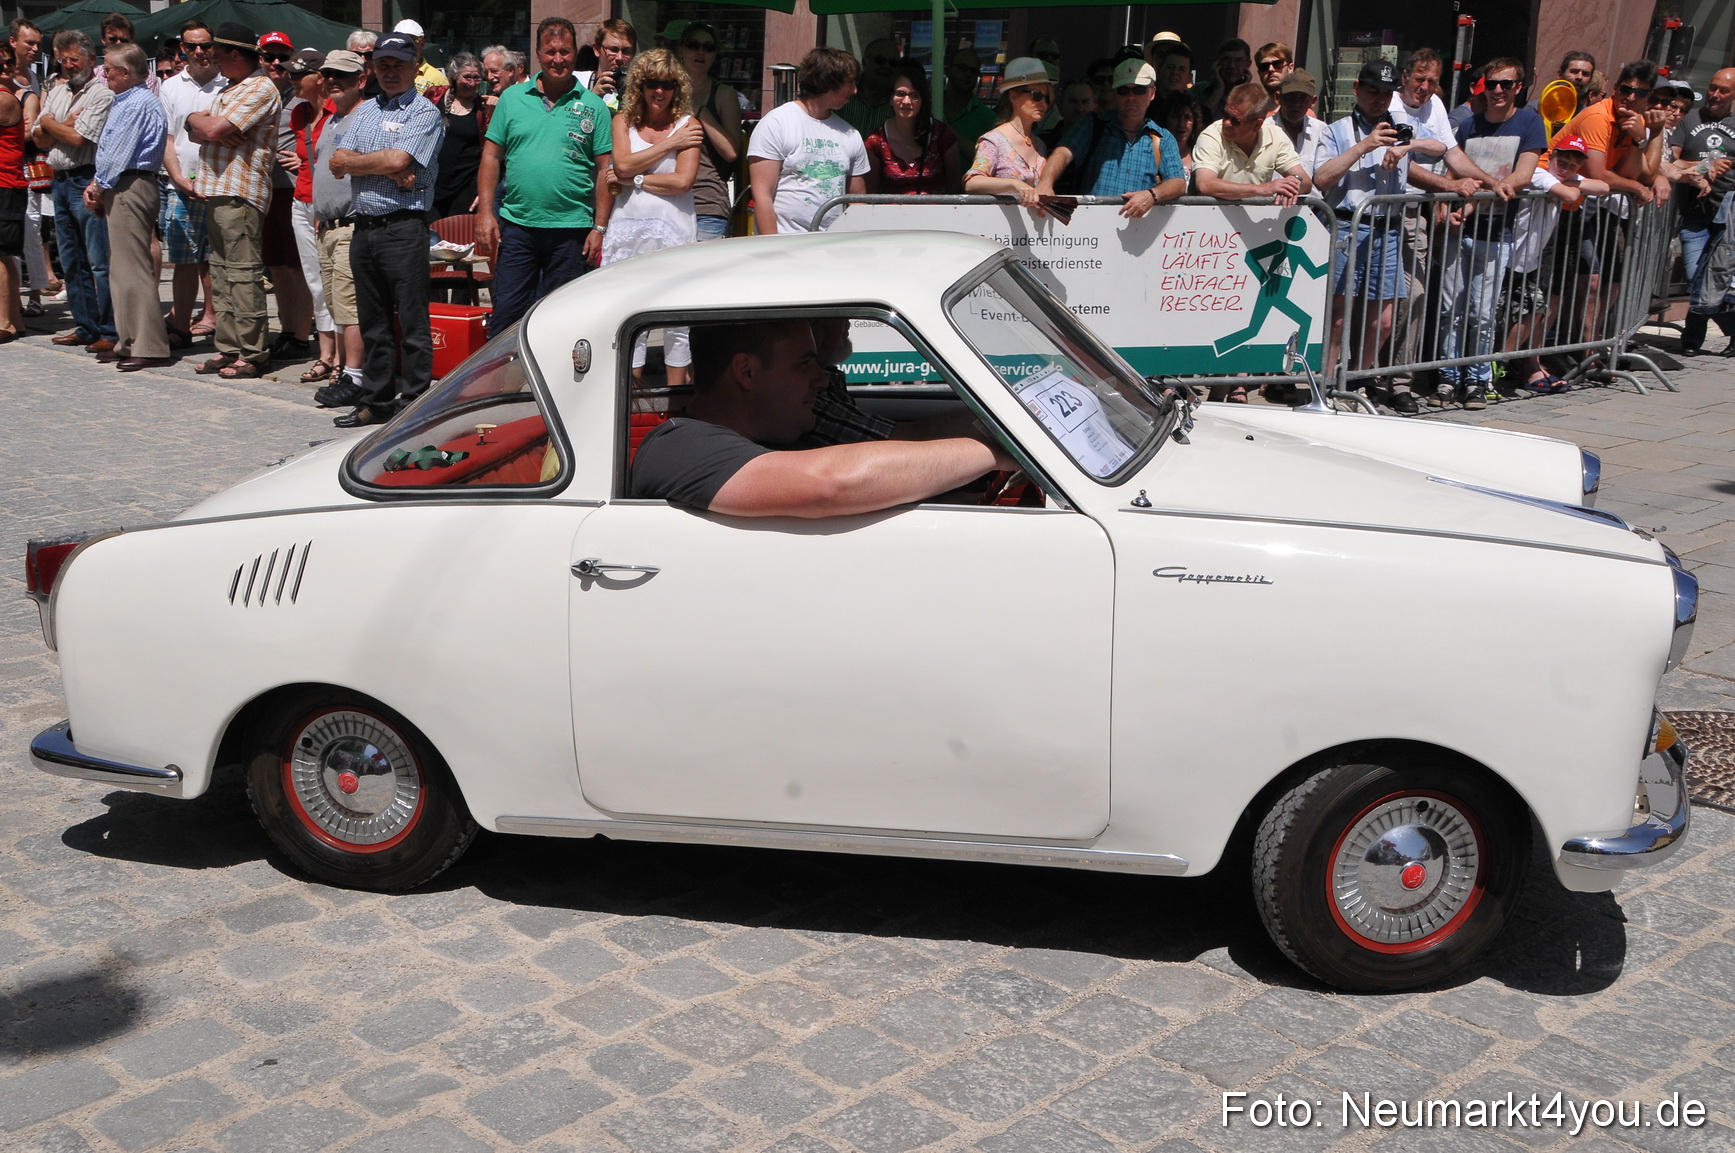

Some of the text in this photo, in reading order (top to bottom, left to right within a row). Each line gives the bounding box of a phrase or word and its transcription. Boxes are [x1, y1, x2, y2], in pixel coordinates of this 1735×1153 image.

[980, 234, 1099, 250] bäudereinigung
[1199, 231, 1242, 249] UNS
[1020, 257, 1103, 270] eisterdienste
[1159, 294, 1243, 312] BESSER.
[1049, 390, 1083, 418] 223
